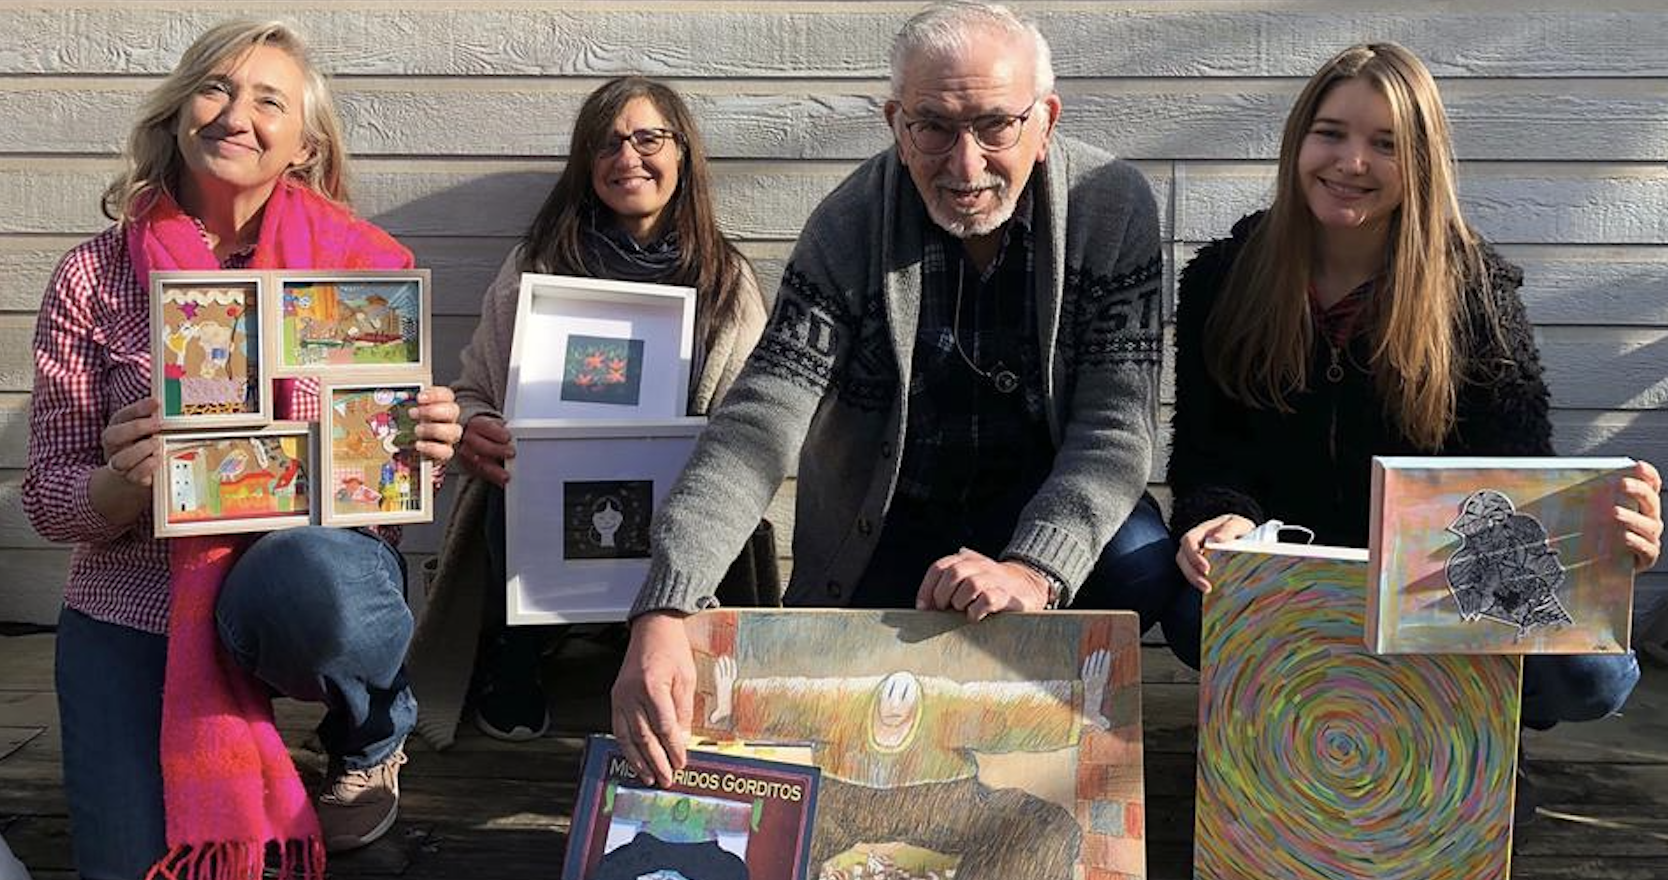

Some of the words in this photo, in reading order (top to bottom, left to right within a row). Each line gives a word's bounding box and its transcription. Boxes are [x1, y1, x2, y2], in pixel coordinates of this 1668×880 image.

[609, 758, 638, 779] MIS
[672, 769, 721, 790] RIDOS
[721, 773, 802, 802] GORDITOS
